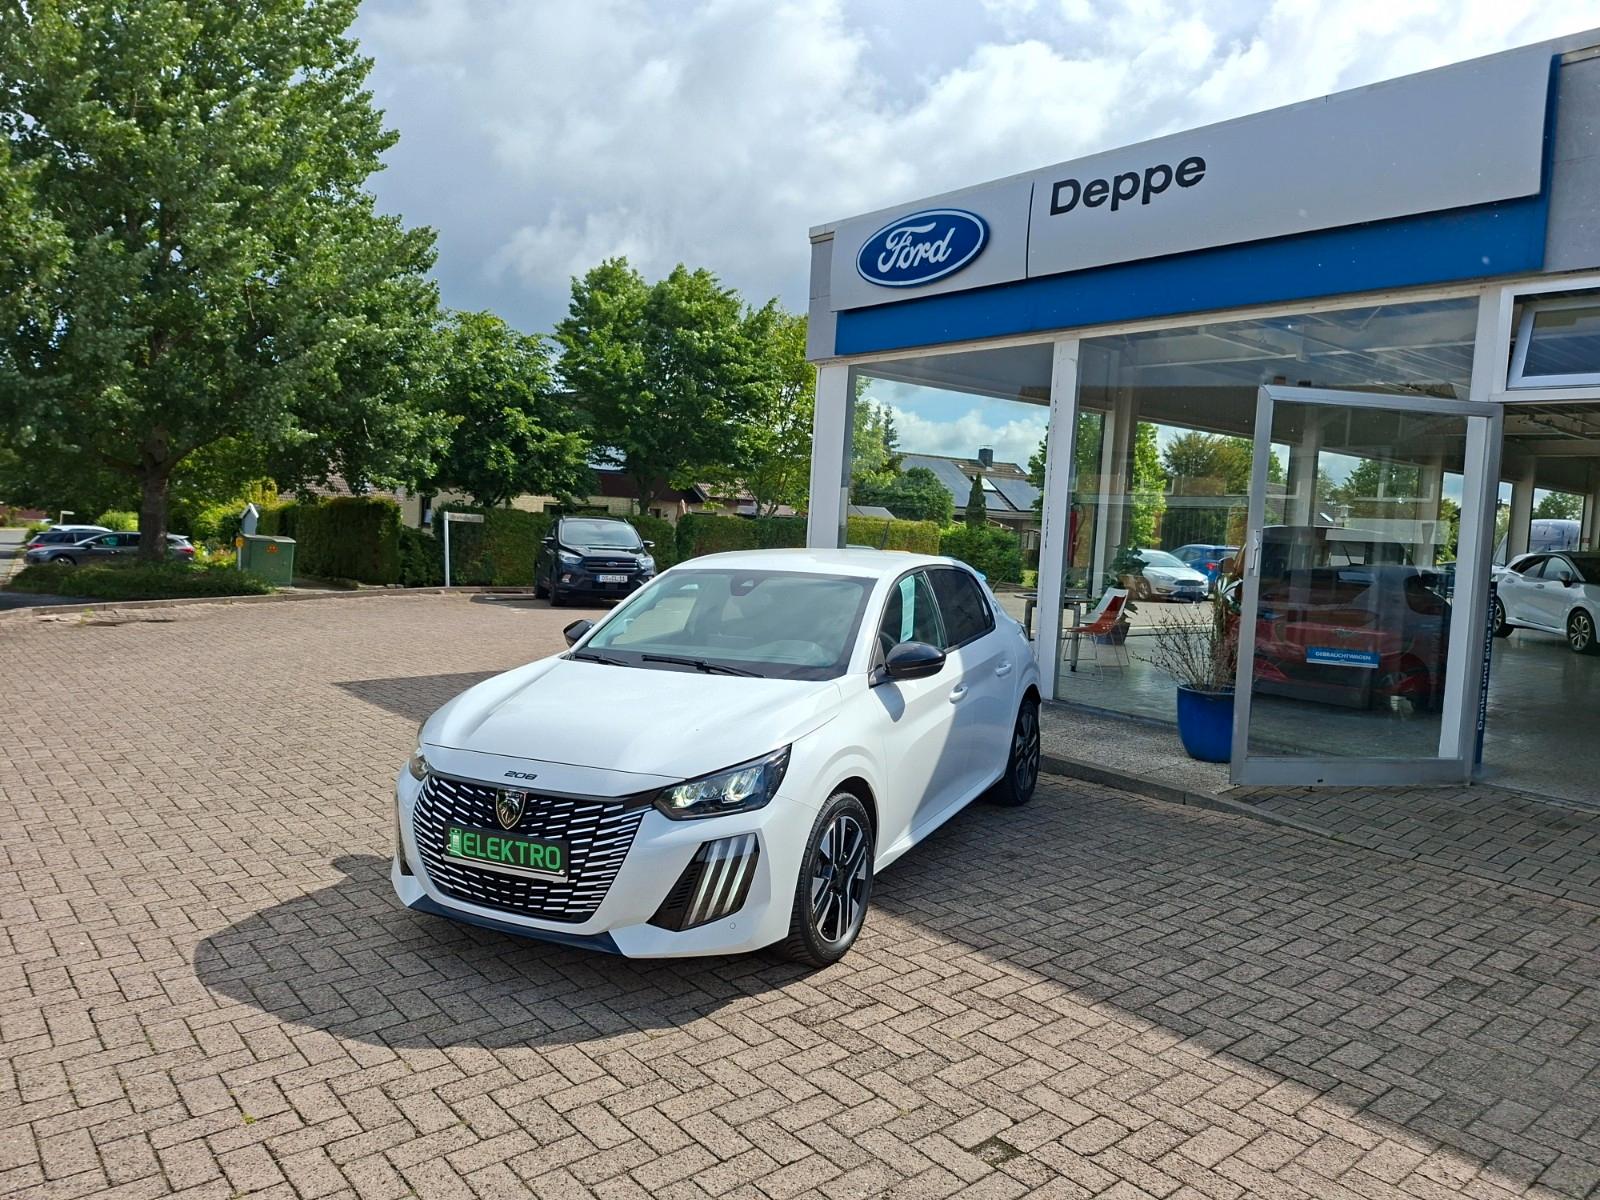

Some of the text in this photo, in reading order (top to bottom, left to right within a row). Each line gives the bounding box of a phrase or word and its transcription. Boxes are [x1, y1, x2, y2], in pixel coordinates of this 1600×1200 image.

[1049, 156, 1206, 216] Deppe
[877, 221, 956, 273] Ford
[1315, 651, 1371, 661] GEBRAUCHTWAGEN
[1477, 690, 1486, 730] Danke
[504, 770, 538, 780] 208
[463, 832, 561, 870] ELEKTRO
